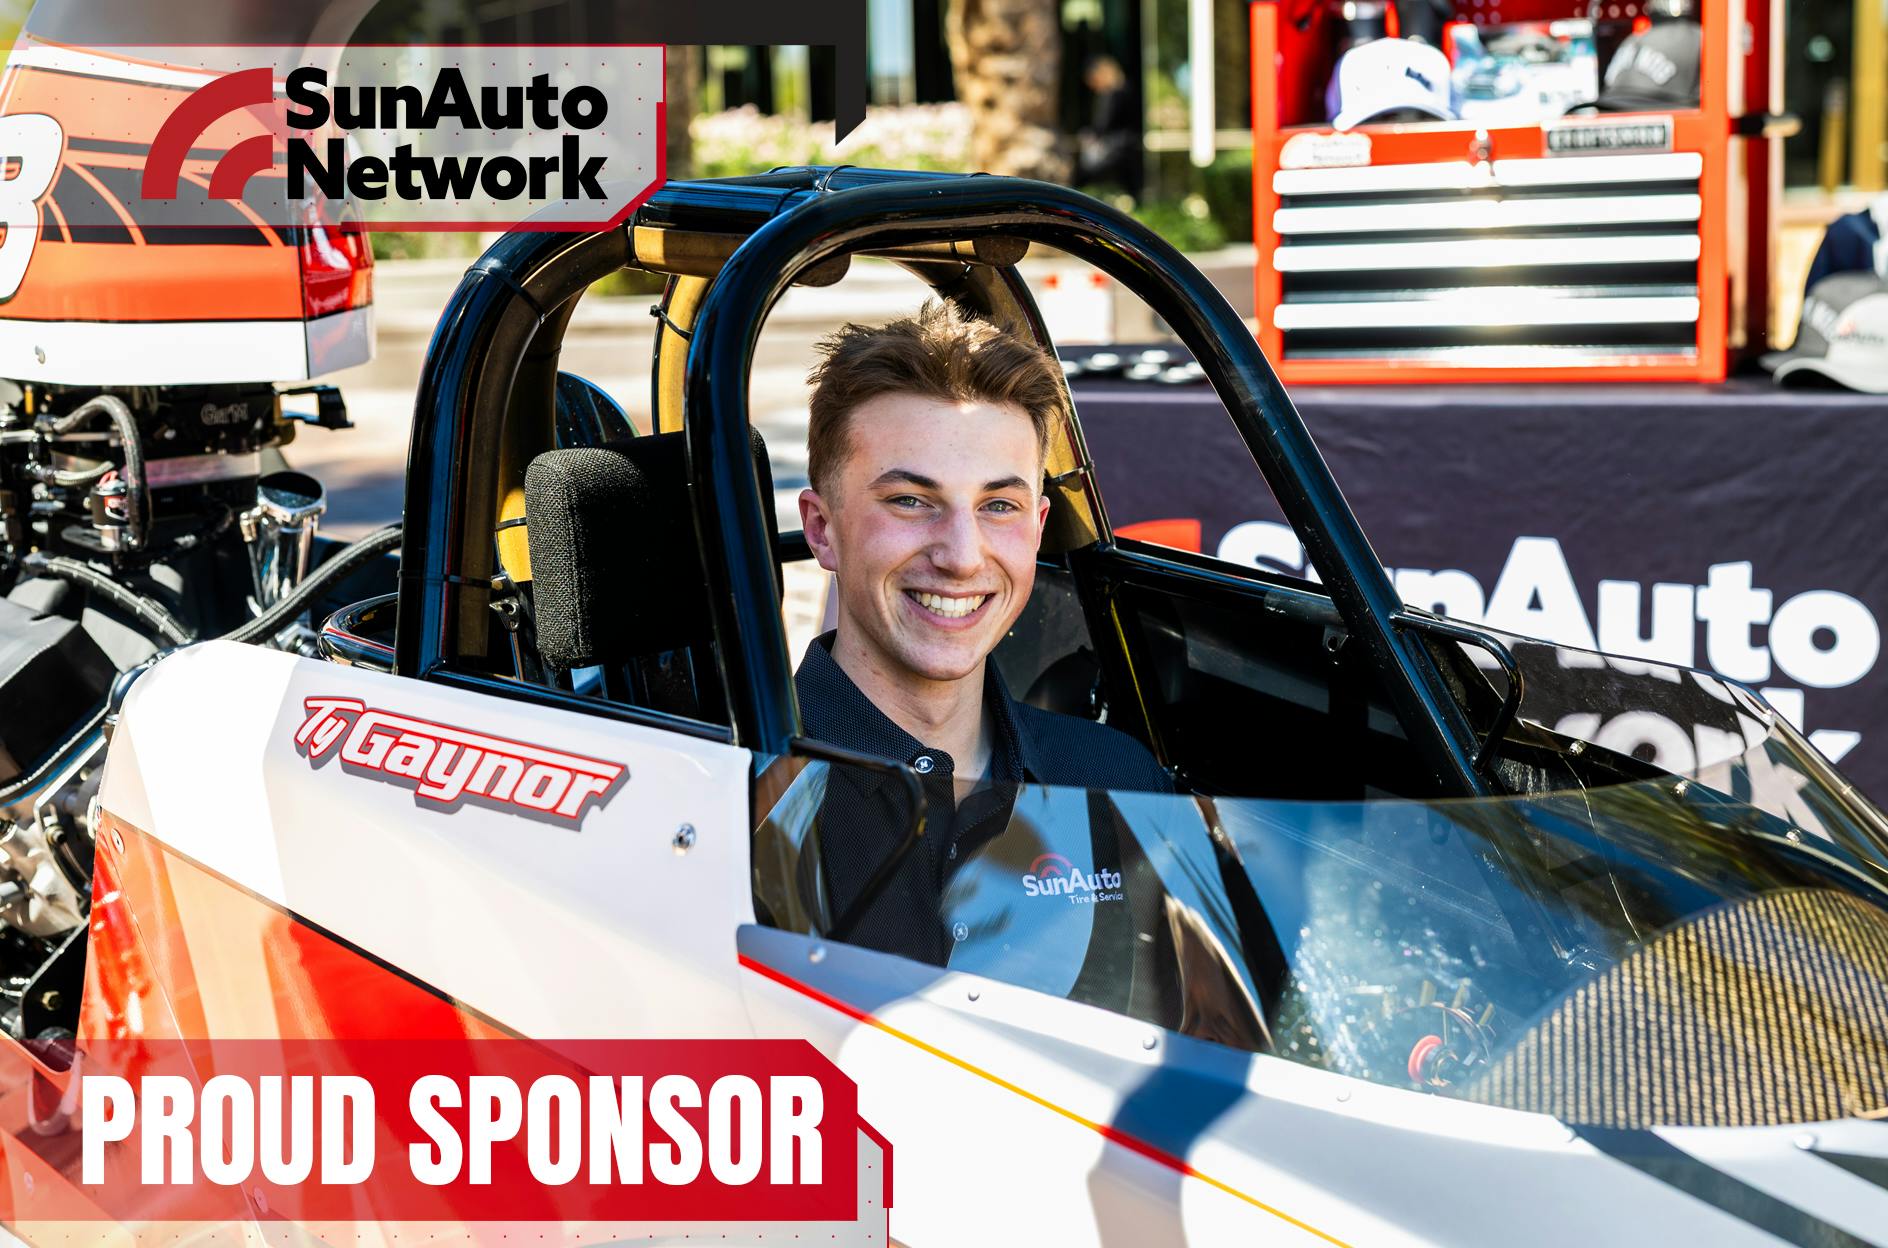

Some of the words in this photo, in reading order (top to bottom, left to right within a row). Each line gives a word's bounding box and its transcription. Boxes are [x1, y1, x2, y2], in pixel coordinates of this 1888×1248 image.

[294, 697, 365, 758] Ty
[340, 709, 627, 819] Gaynor
[1022, 868, 1121, 897] SunAuto
[1068, 895, 1090, 904] Tire
